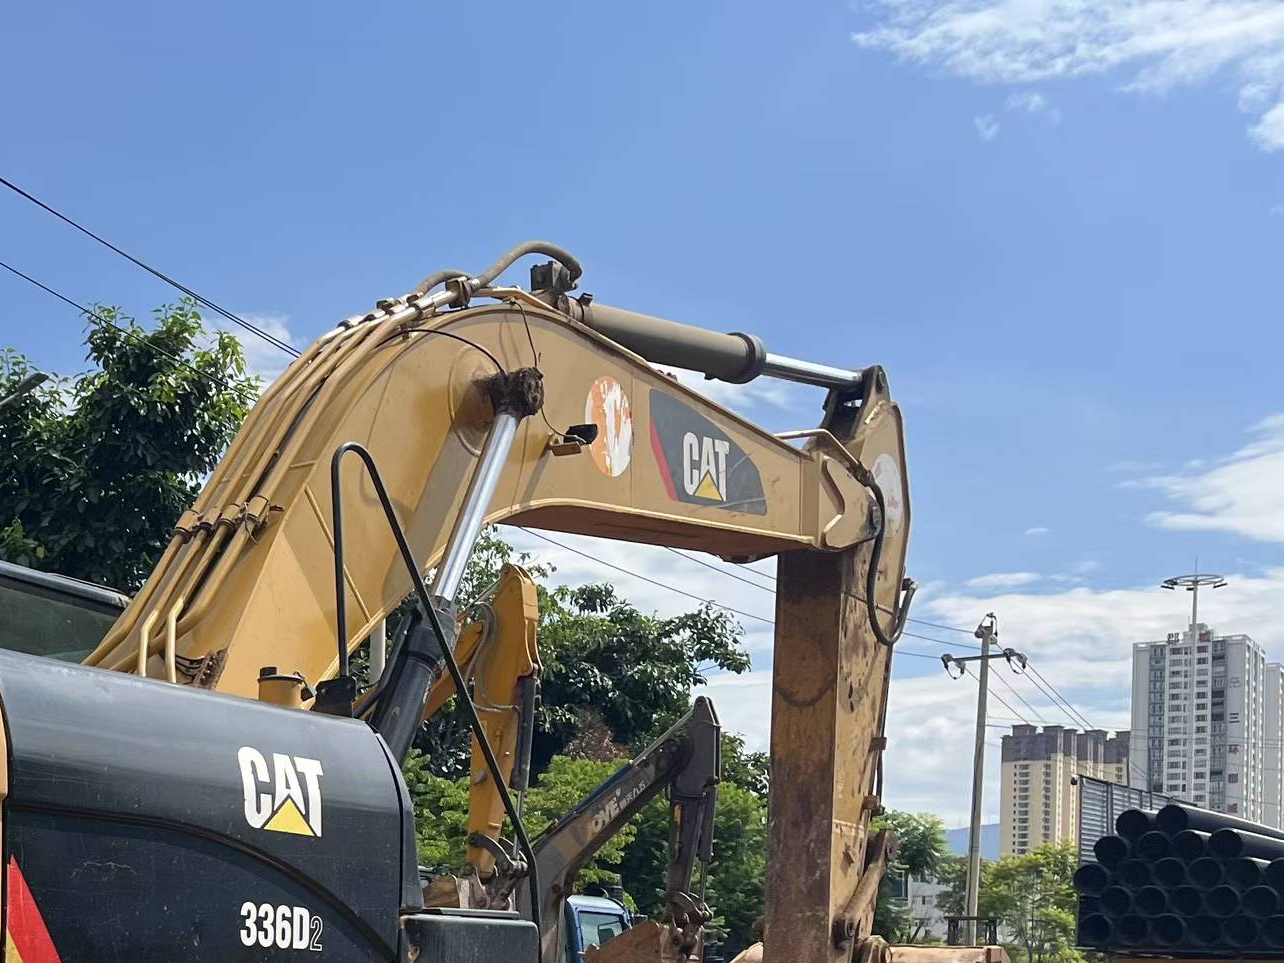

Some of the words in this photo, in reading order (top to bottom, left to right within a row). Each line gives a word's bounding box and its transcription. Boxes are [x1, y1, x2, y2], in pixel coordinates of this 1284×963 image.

[683, 432, 730, 502] CAT
[238, 746, 323, 837] CAT
[239, 901, 323, 952] 336D2
